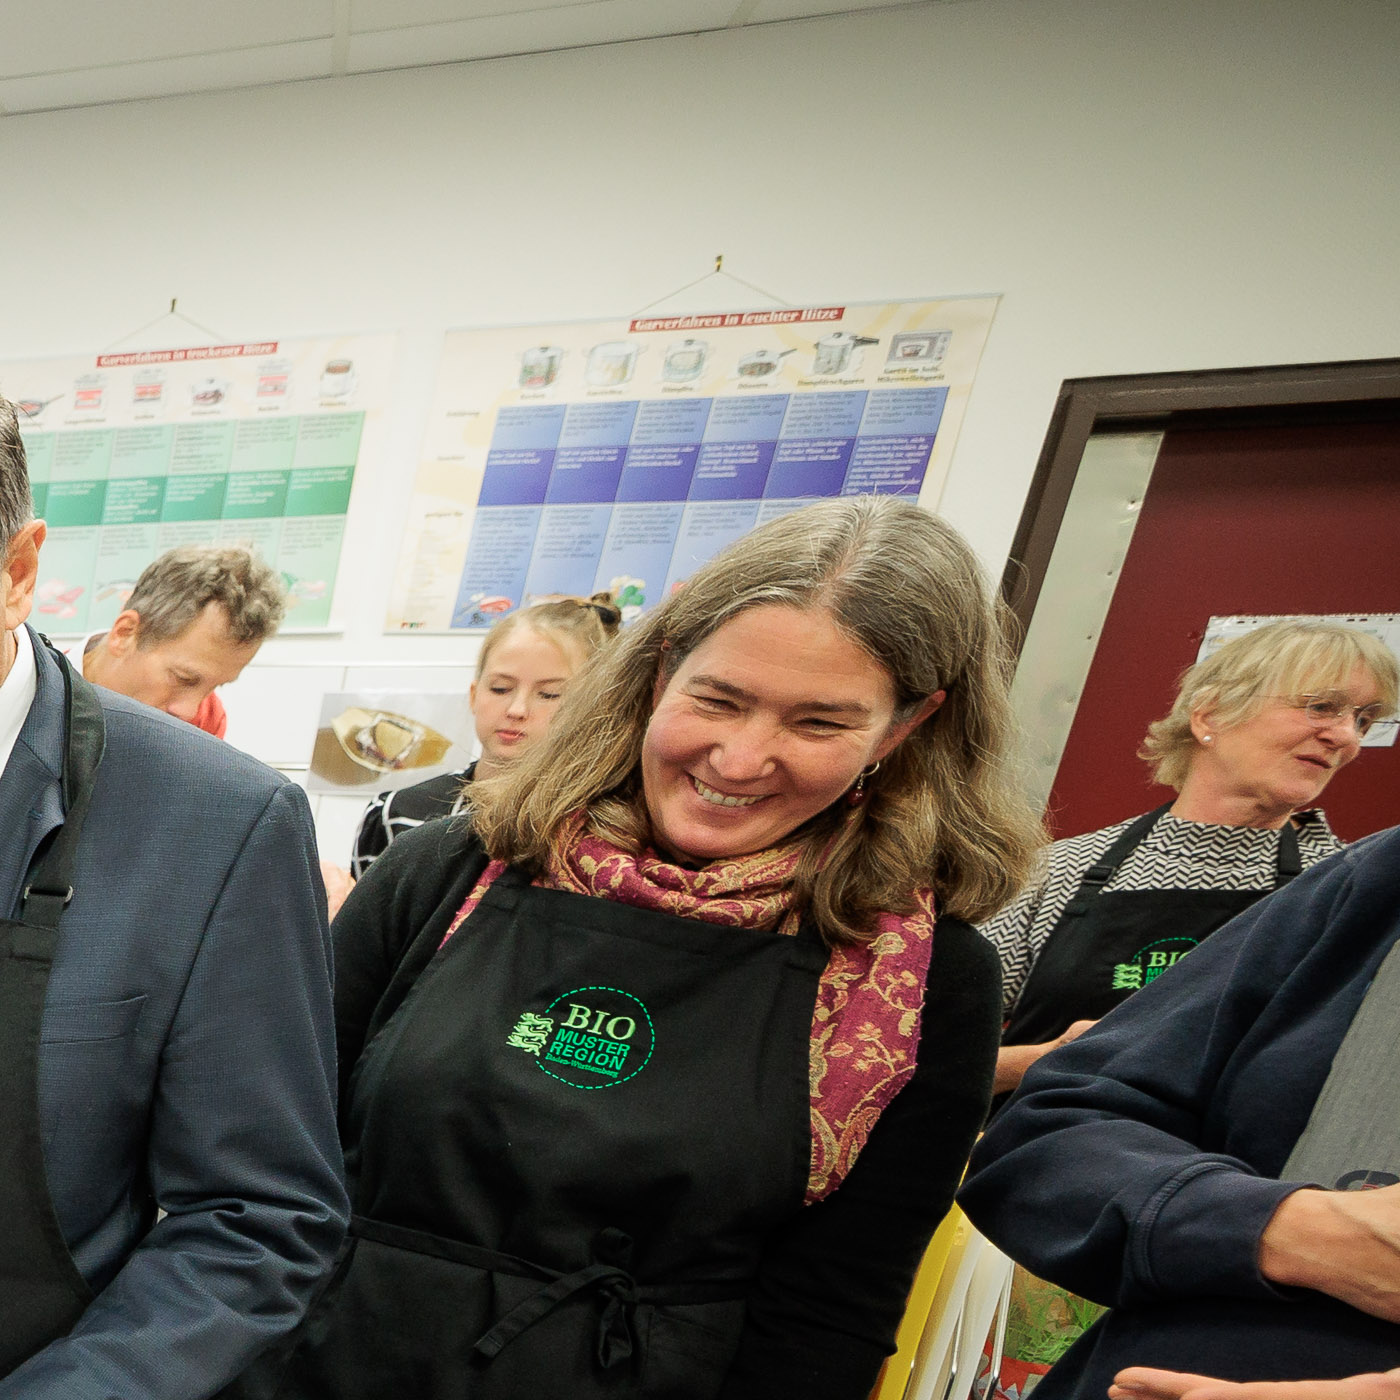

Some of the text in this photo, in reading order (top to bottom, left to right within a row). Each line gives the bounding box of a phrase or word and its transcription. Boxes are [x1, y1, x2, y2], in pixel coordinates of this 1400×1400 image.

[724, 314, 739, 326] in
[1147, 951, 1190, 967] BI
[560, 1003, 636, 1041] BIO
[550, 1041, 626, 1070] REGION
[555, 1028, 630, 1057] MUSTER
